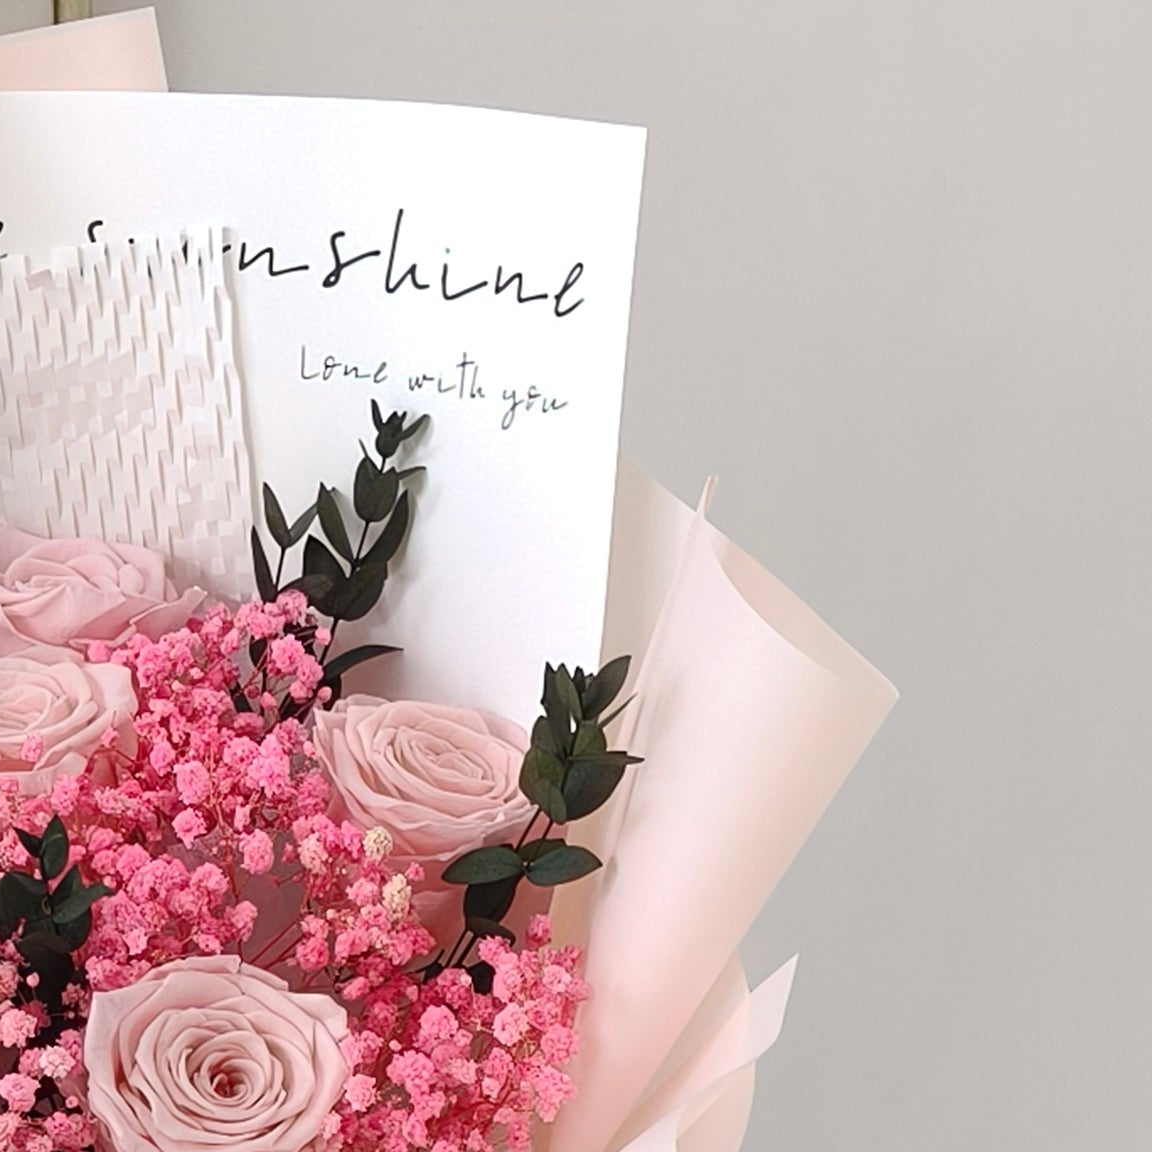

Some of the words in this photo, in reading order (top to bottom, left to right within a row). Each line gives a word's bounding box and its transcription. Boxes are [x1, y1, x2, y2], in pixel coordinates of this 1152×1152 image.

[87, 207, 584, 318] nshine
[408, 352, 486, 399] with
[501, 385, 570, 431] you
